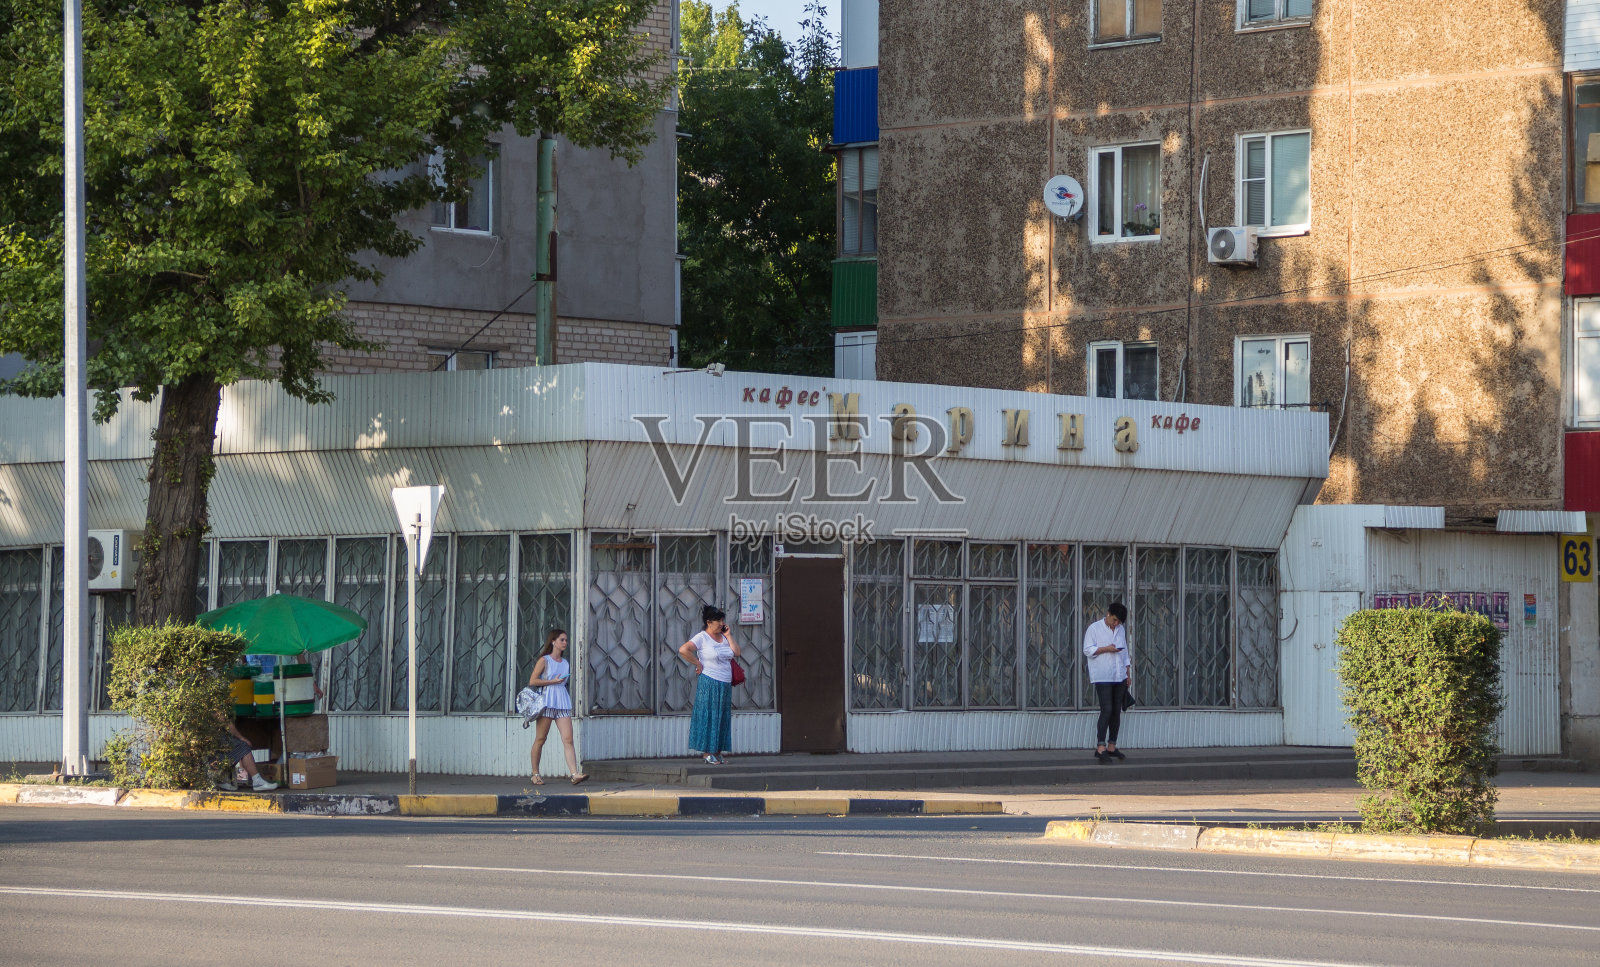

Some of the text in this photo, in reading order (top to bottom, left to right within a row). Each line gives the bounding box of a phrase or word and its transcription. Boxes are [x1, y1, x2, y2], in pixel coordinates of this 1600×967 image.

[826, 392, 1139, 453] Марина
[1151, 413, 1201, 434] кафе
[1564, 540, 1591, 576] 63
